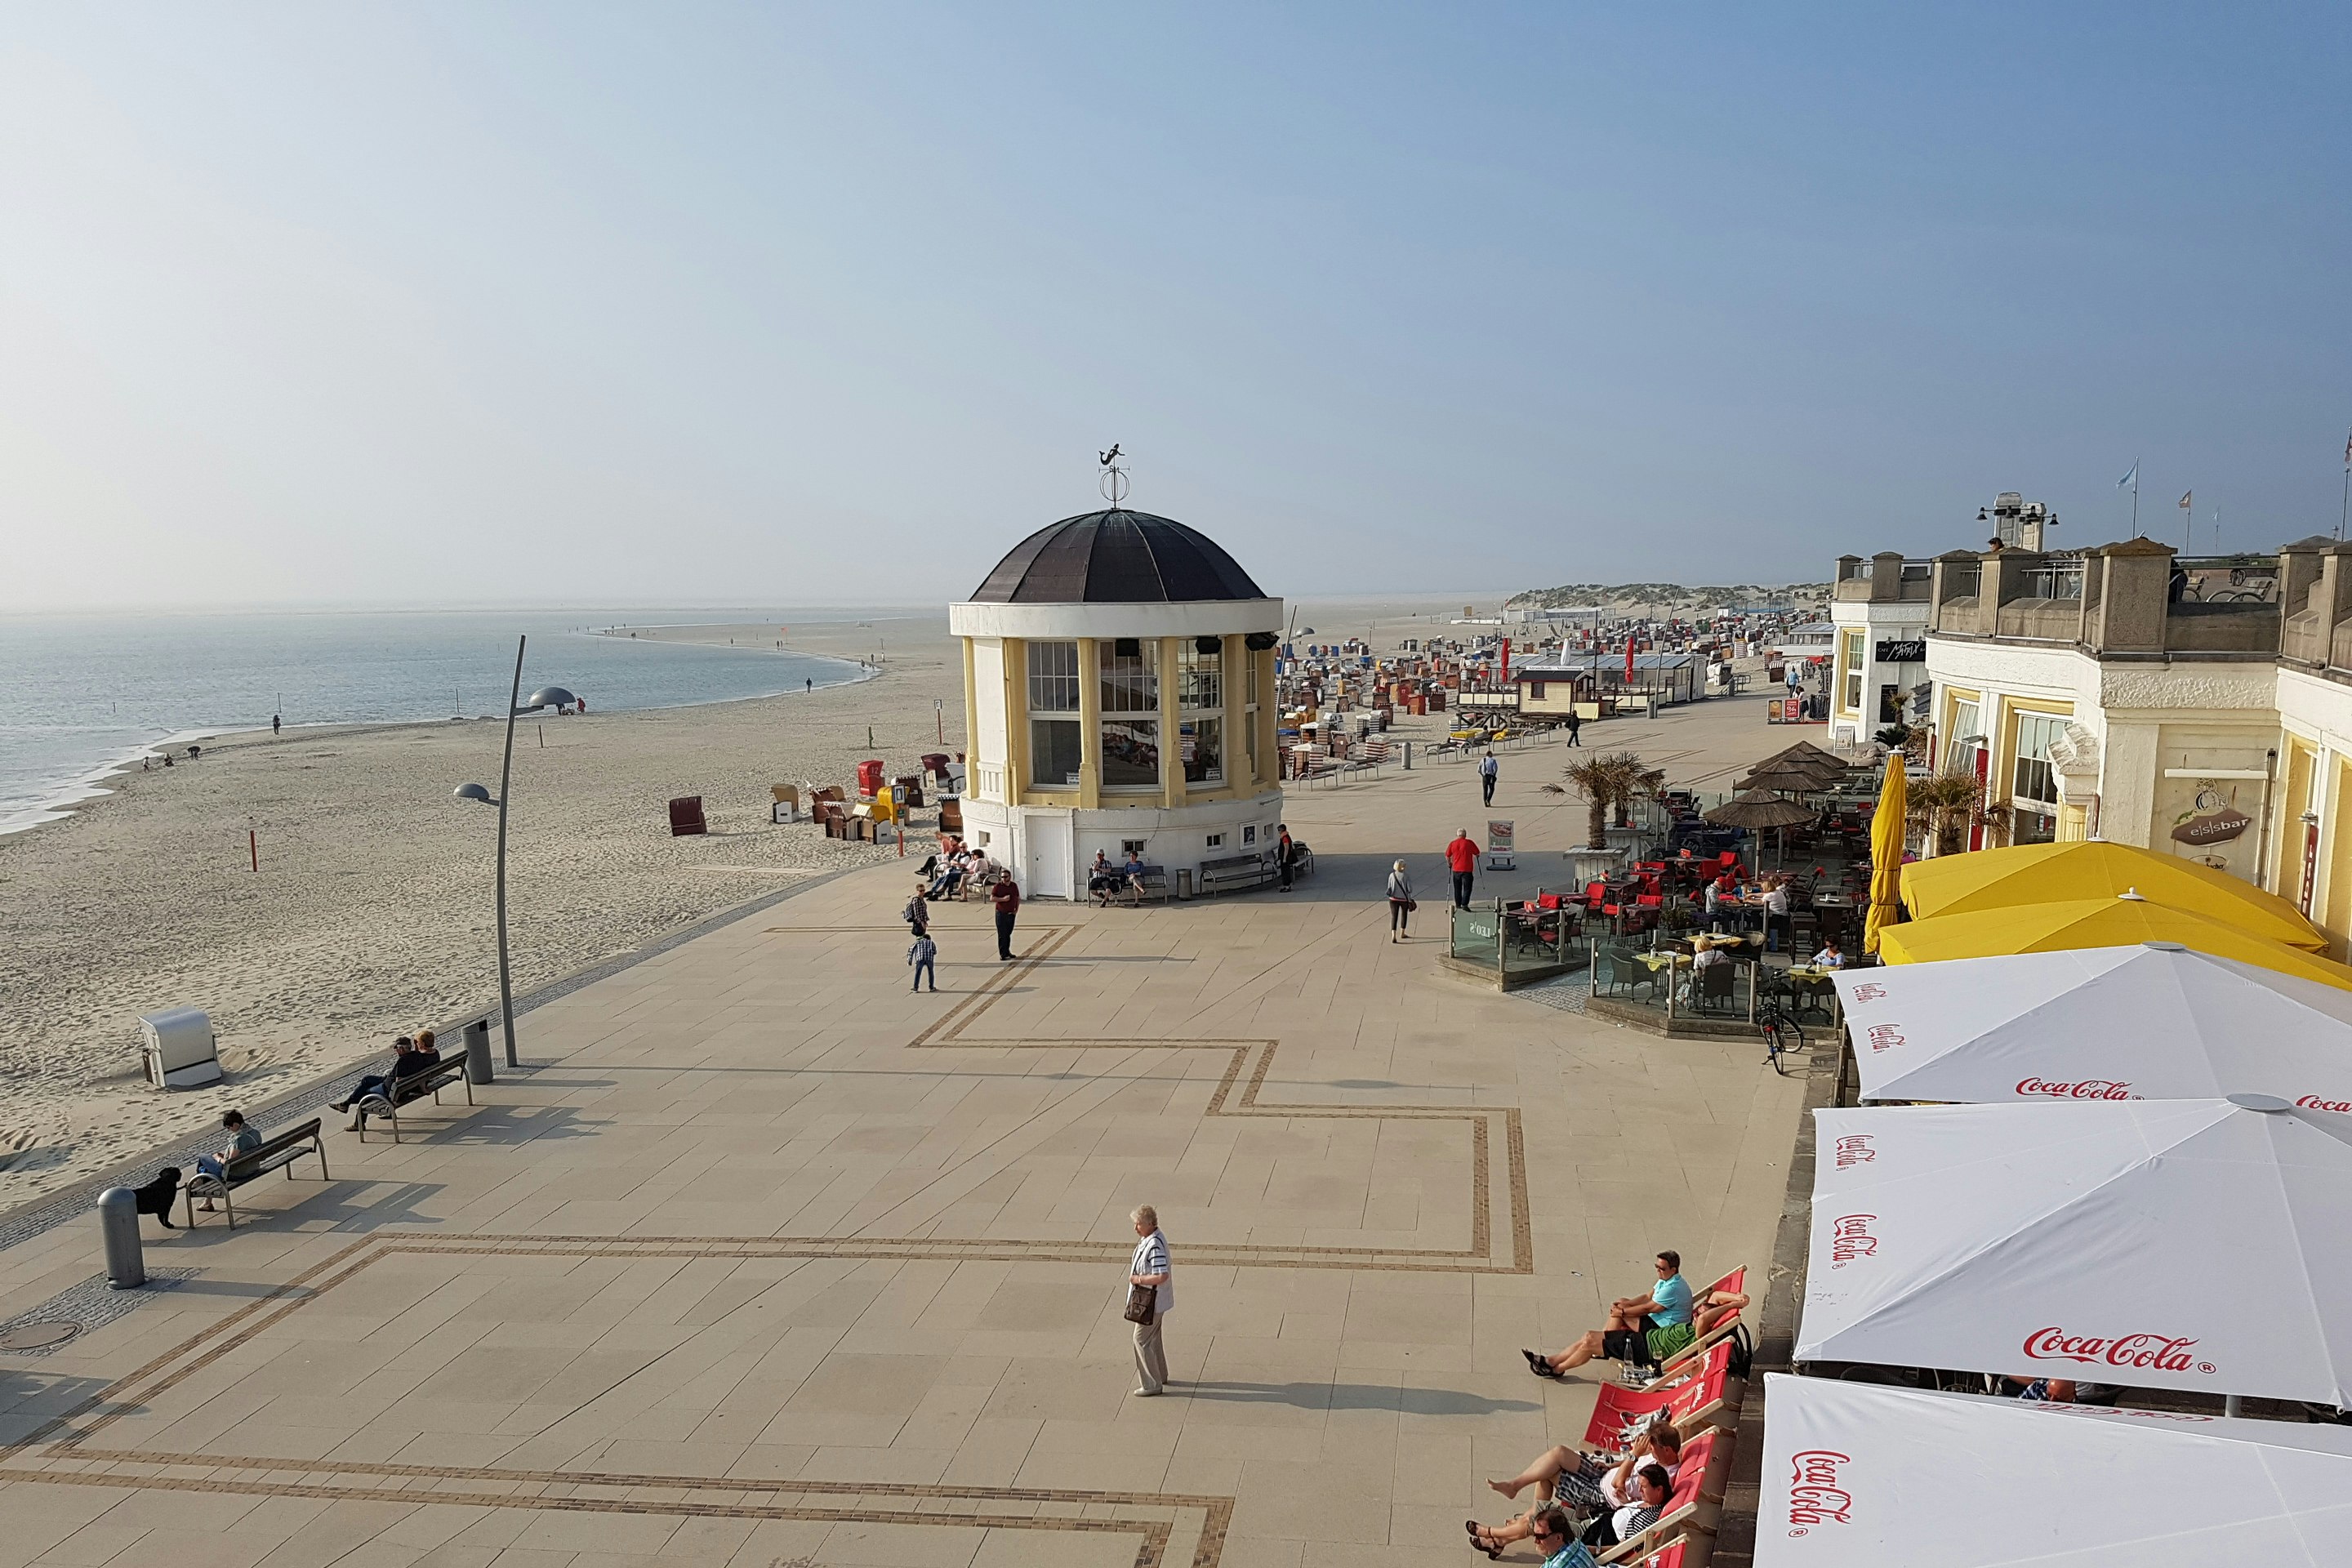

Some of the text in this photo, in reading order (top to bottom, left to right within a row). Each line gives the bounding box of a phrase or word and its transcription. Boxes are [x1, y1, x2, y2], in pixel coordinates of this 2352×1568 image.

[2016, 1077, 2133, 1101] Coca-Cola
[1836, 1134, 1876, 1166] Coca-Cola
[1832, 1214, 1878, 1262] Coca-Cola
[2023, 1327, 2200, 1372] Coca-Cola
[1788, 1450, 1852, 1526] Coca-Cola
